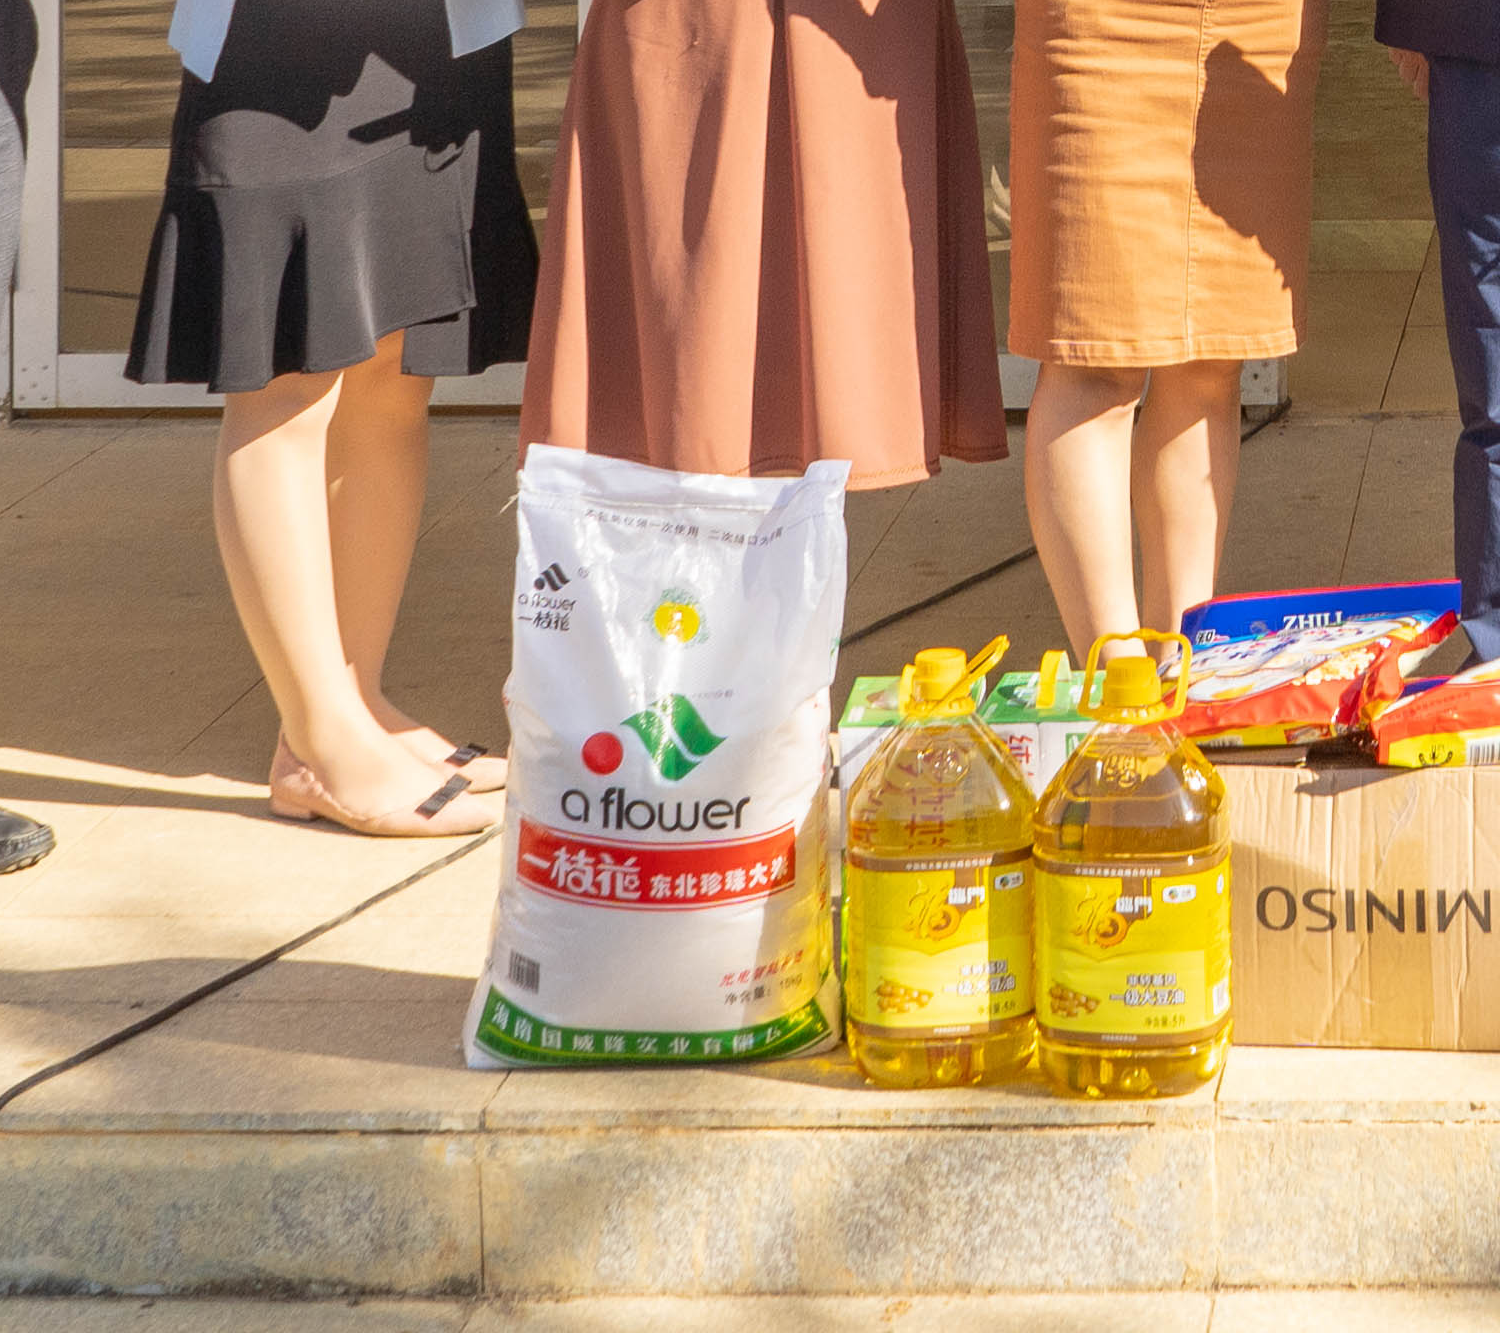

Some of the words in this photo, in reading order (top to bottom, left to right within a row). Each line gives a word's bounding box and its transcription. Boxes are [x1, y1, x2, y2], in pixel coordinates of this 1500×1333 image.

[560, 789, 590, 823] a
[599, 786, 750, 833] flower
[650, 855, 789, 900] 东北珍珠大米
[1256, 885, 1492, 934] MINISO
[491, 1001, 810, 1055] 海南国威隆实业有限公
